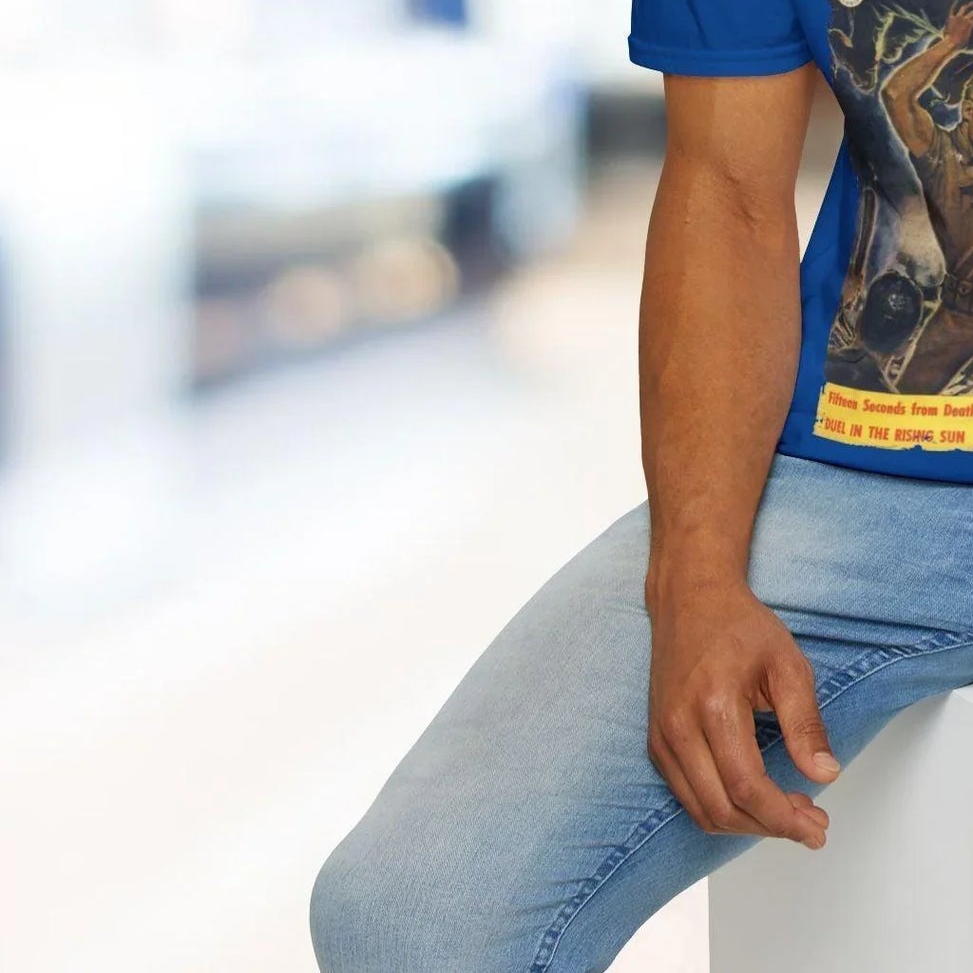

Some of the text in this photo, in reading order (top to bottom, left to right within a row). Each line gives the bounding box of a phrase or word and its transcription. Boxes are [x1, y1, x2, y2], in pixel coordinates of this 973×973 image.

[828, 391, 858, 410] Fifteen
[862, 399, 906, 416] Seconds
[911, 402, 938, 416] from
[824, 417, 846, 435] DUEL
[849, 424, 862, 438] IN
[868, 426, 890, 440] THE
[939, 430, 966, 444] SUN
